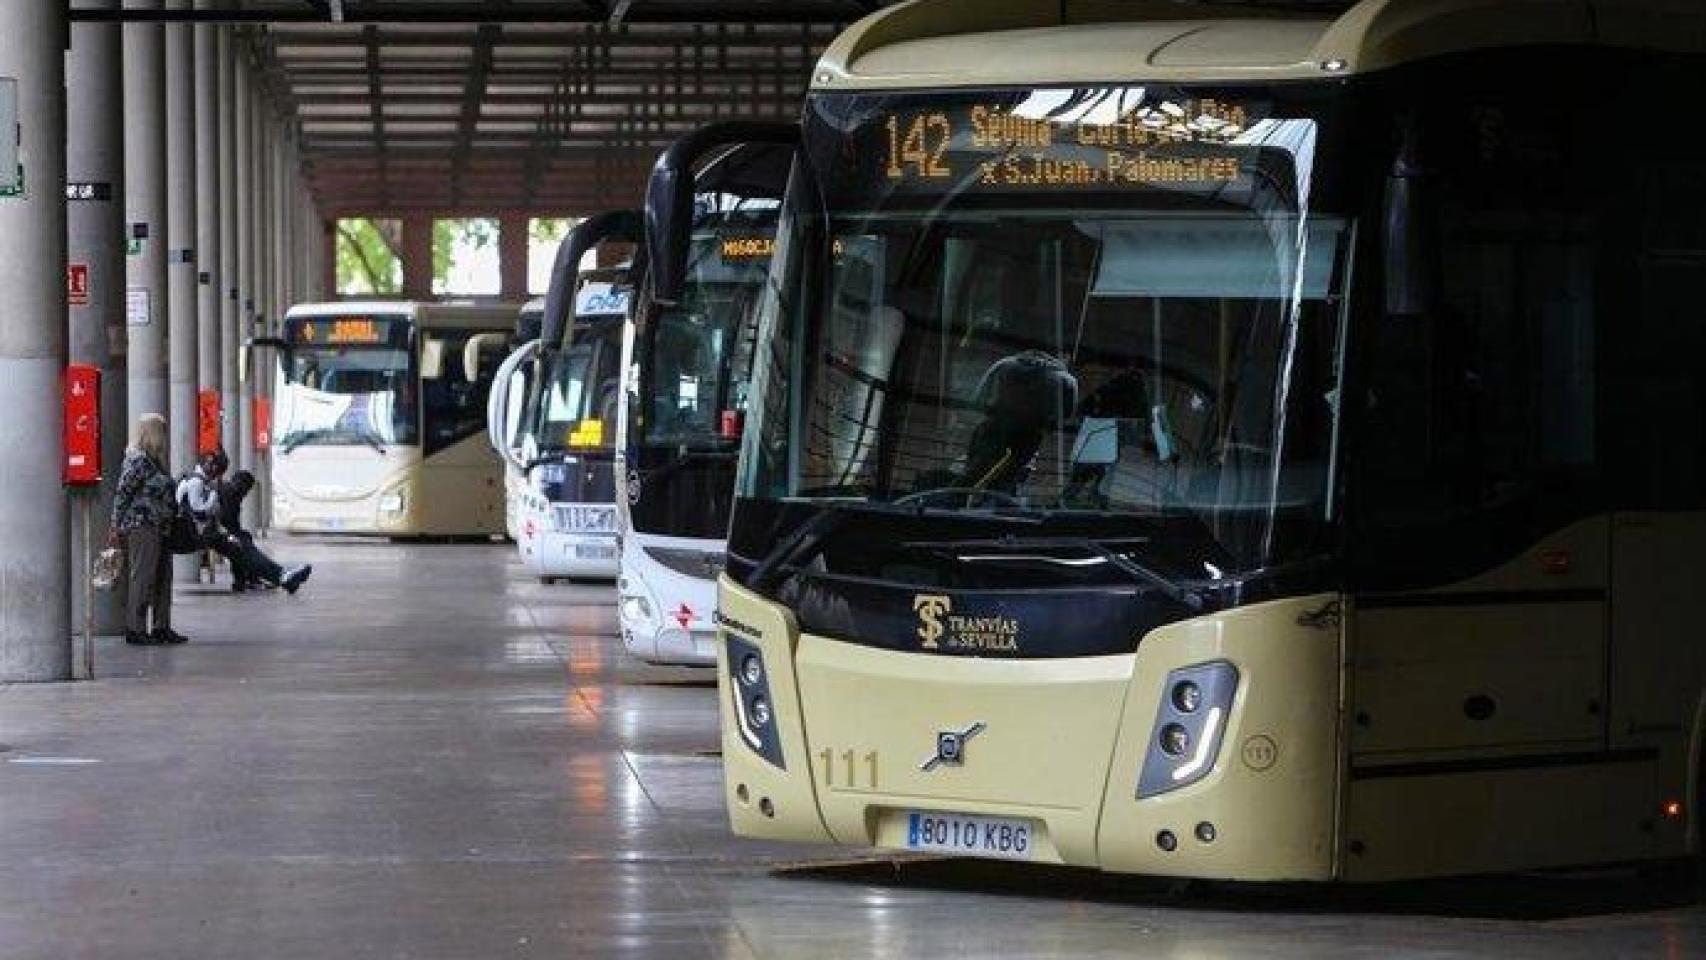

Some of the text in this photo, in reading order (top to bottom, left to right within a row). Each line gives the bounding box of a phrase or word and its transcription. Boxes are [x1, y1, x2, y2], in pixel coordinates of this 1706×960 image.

[887, 113, 951, 177] 142
[1107, 150, 1238, 181] Palomares
[820, 748, 879, 787] 111
[921, 818, 1028, 853] 8010 KBG
